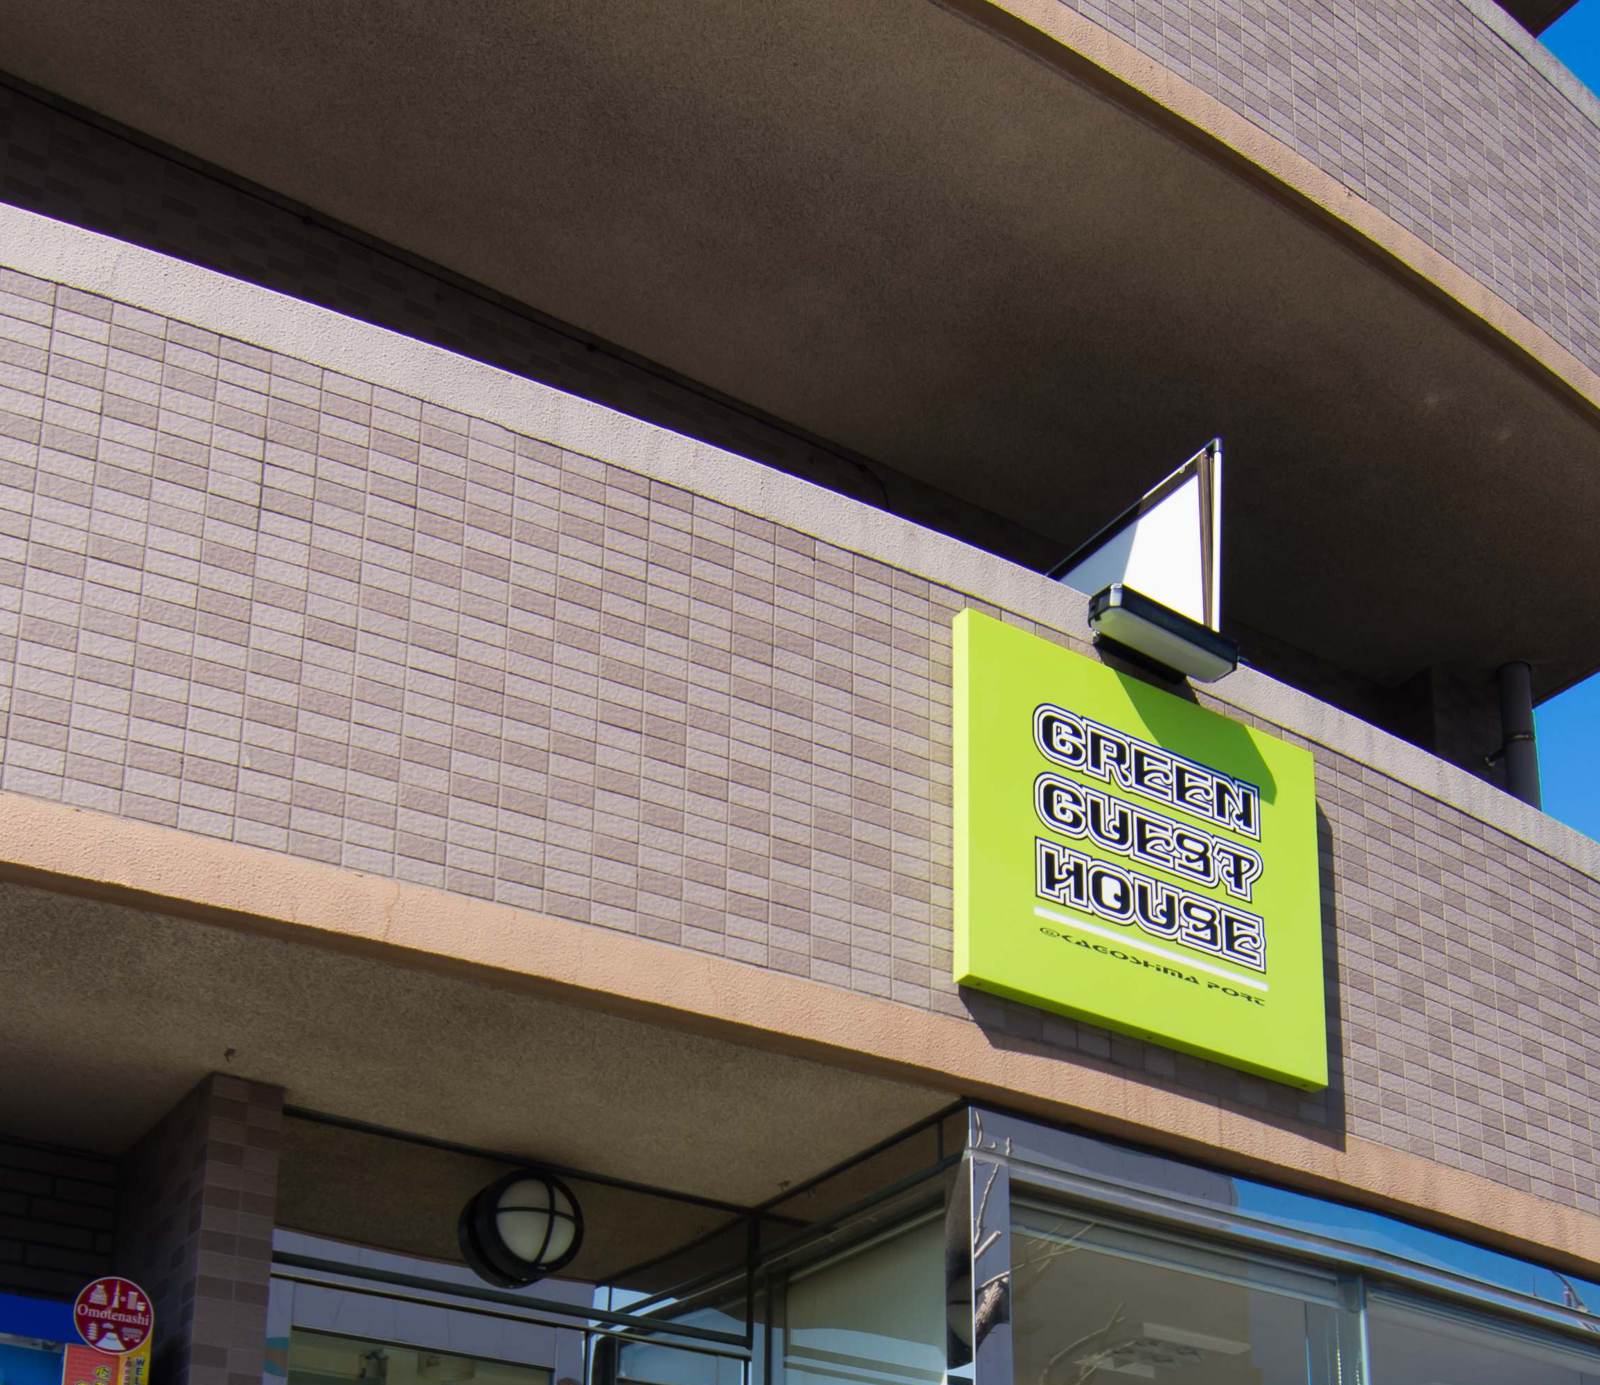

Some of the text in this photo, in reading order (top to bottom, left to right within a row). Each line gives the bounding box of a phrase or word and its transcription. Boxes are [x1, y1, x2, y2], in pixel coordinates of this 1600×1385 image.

[1032, 703, 1261, 841] GREEN
[1033, 772, 1263, 903] GUEST
[1034, 836, 1266, 973] HOUSE
[77, 1303, 149, 1326] Omotenashi
